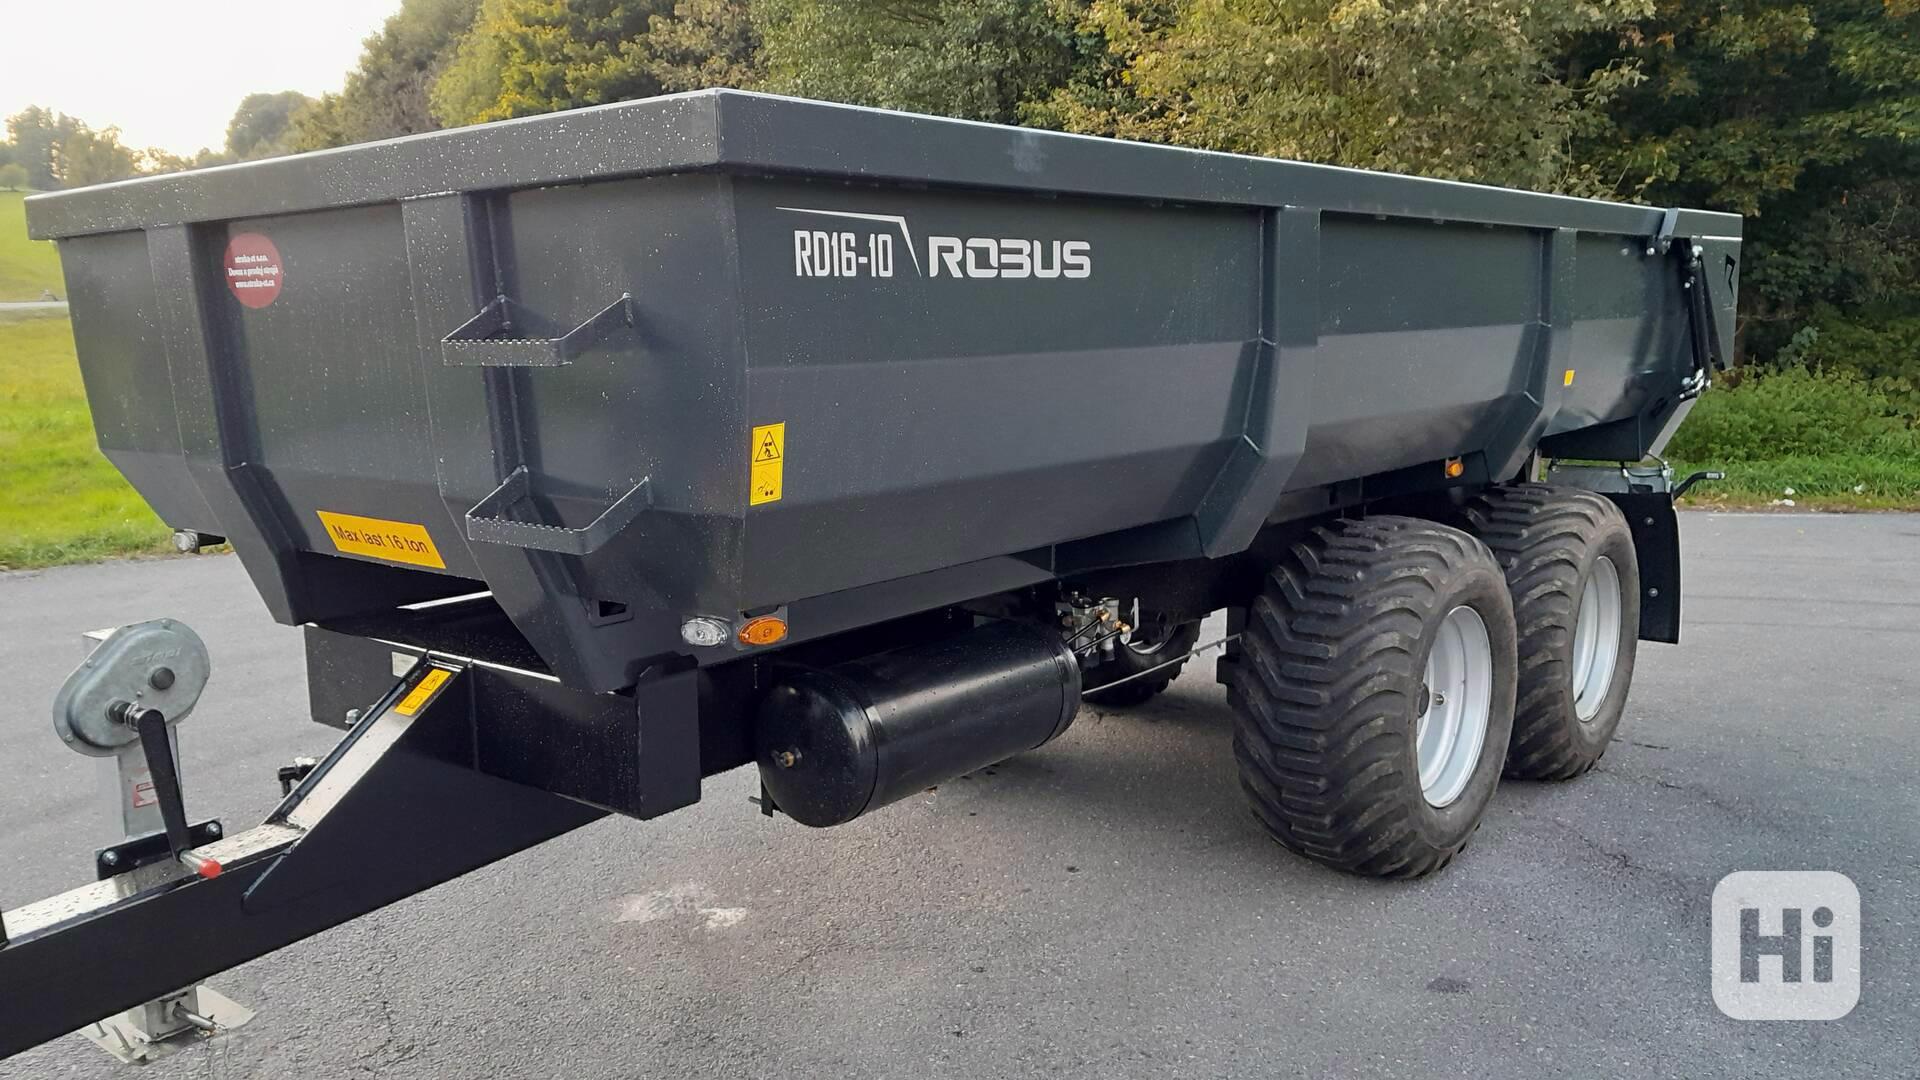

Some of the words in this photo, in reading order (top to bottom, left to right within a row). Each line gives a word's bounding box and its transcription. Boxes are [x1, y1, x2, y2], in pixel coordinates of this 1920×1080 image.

[794, 230, 893, 277] RD16-10
[928, 236, 1091, 278] ROBUS
[332, 525, 360, 543] Max
[360, 529, 386, 548] last
[386, 533, 404, 550] 16
[404, 537, 430, 553] ton
